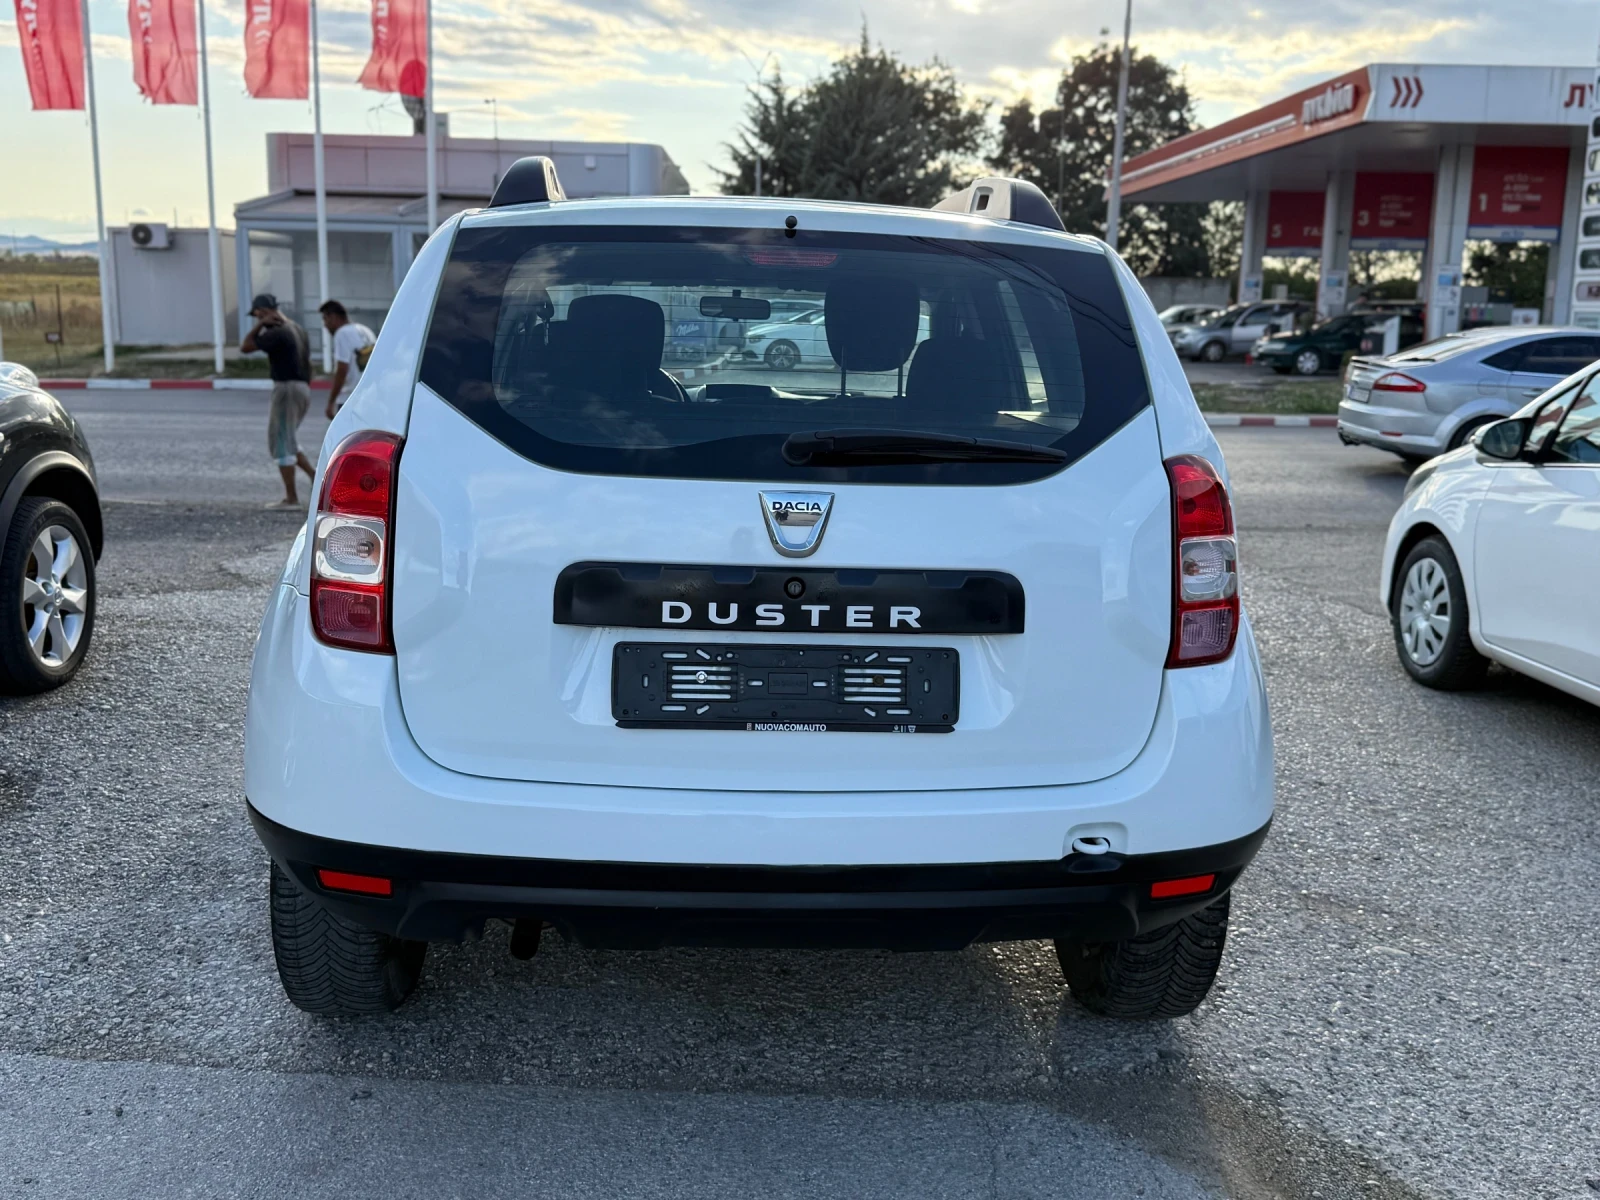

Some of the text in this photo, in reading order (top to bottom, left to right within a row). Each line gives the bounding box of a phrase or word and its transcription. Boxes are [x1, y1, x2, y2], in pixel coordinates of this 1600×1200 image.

[1479, 193, 1488, 212] 1
[1357, 209, 1369, 226] 3
[772, 501, 822, 512] DACIA
[661, 601, 922, 628] DUSTER
[754, 722, 827, 733] NUOVACOMAUTO
